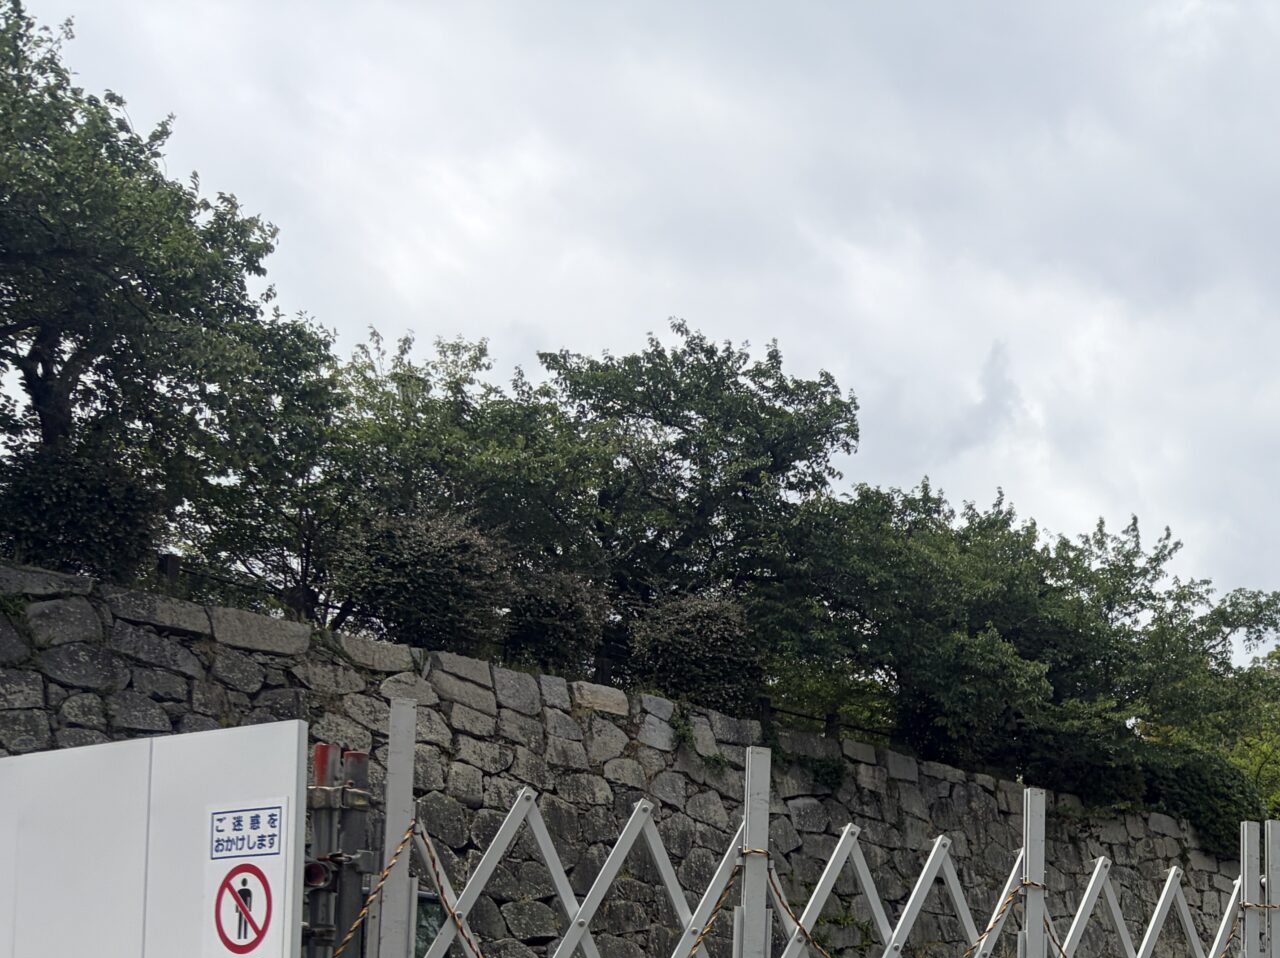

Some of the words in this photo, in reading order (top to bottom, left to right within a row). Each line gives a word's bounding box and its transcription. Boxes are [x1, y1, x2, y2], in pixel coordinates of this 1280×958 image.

[215, 813, 278, 832] ご迷惑を
[214, 833, 278, 853] おかけします
